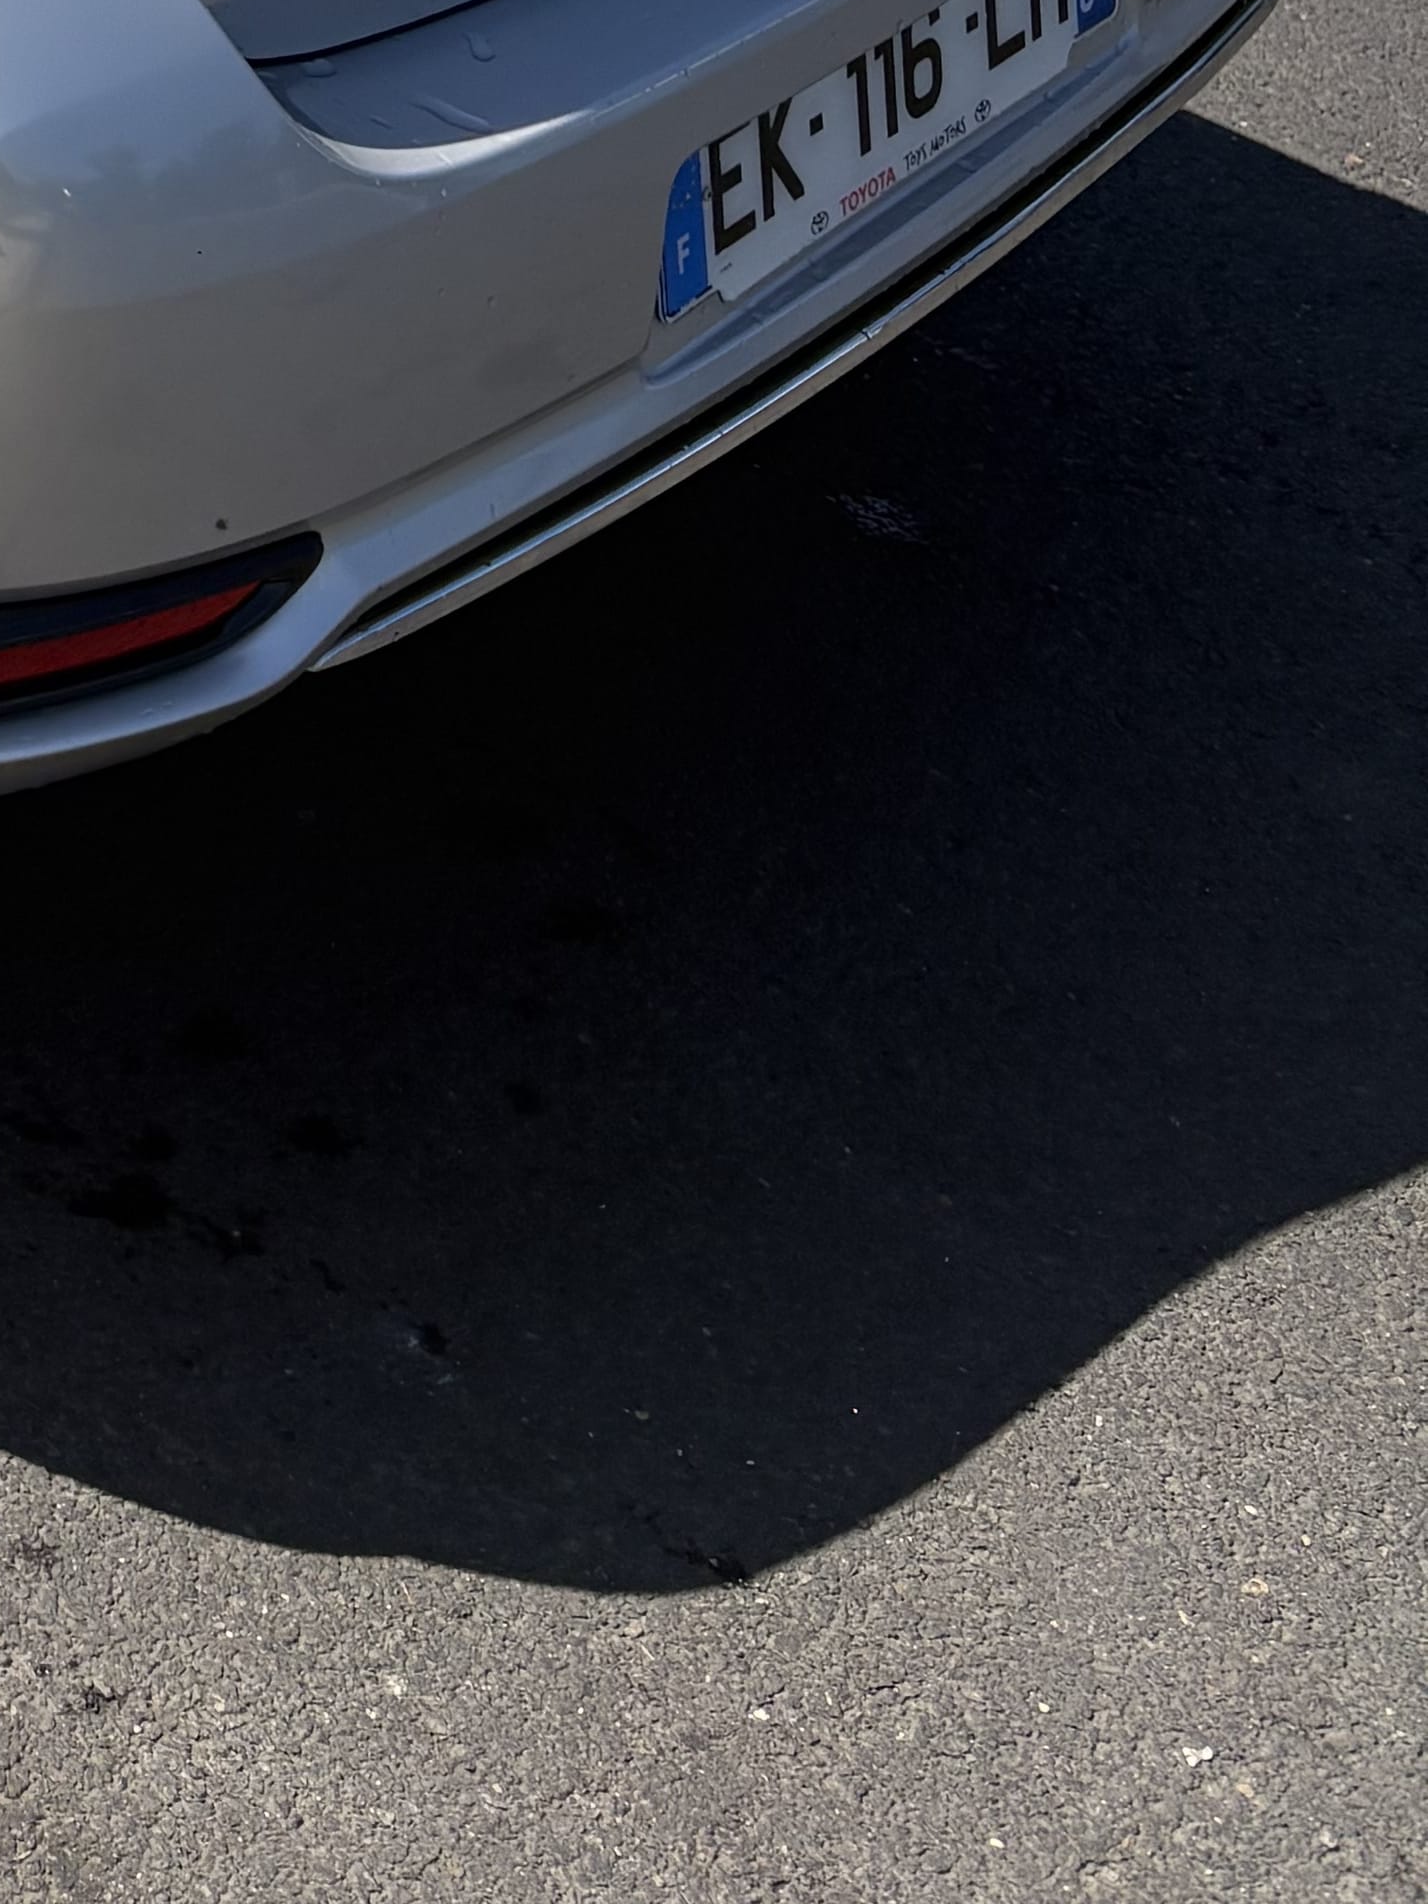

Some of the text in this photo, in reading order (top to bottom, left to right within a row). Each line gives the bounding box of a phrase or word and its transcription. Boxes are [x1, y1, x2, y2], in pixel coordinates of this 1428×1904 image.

[839, 166, 897, 217] TOYOTA
[929, 115, 967, 156] MOTORS
[676, 231, 691, 275] F
